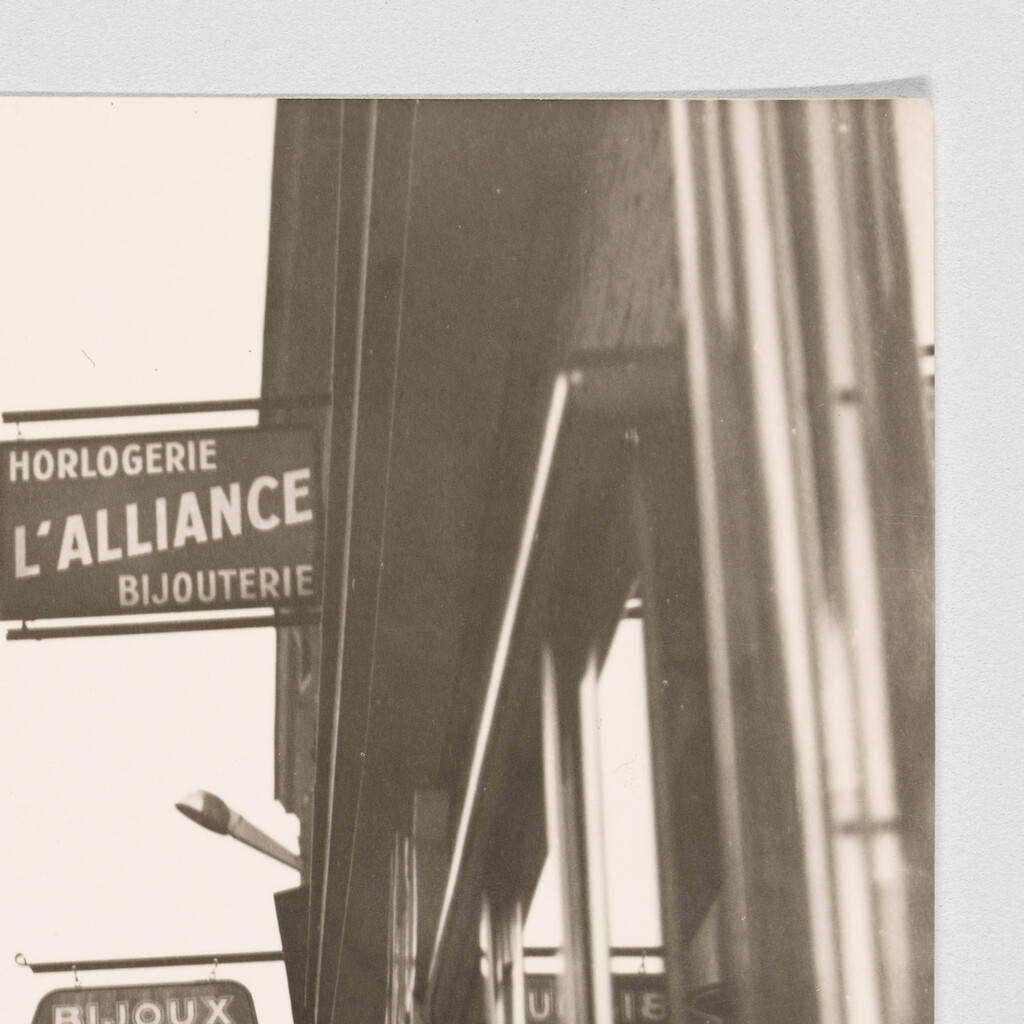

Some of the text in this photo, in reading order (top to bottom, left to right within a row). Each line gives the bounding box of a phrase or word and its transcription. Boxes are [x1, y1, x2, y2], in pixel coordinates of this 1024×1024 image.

[9, 439, 218, 482] HORLOGERIE
[14, 467, 314, 578] L'ALLIANCE
[118, 565, 314, 607] BIJOUTERIE
